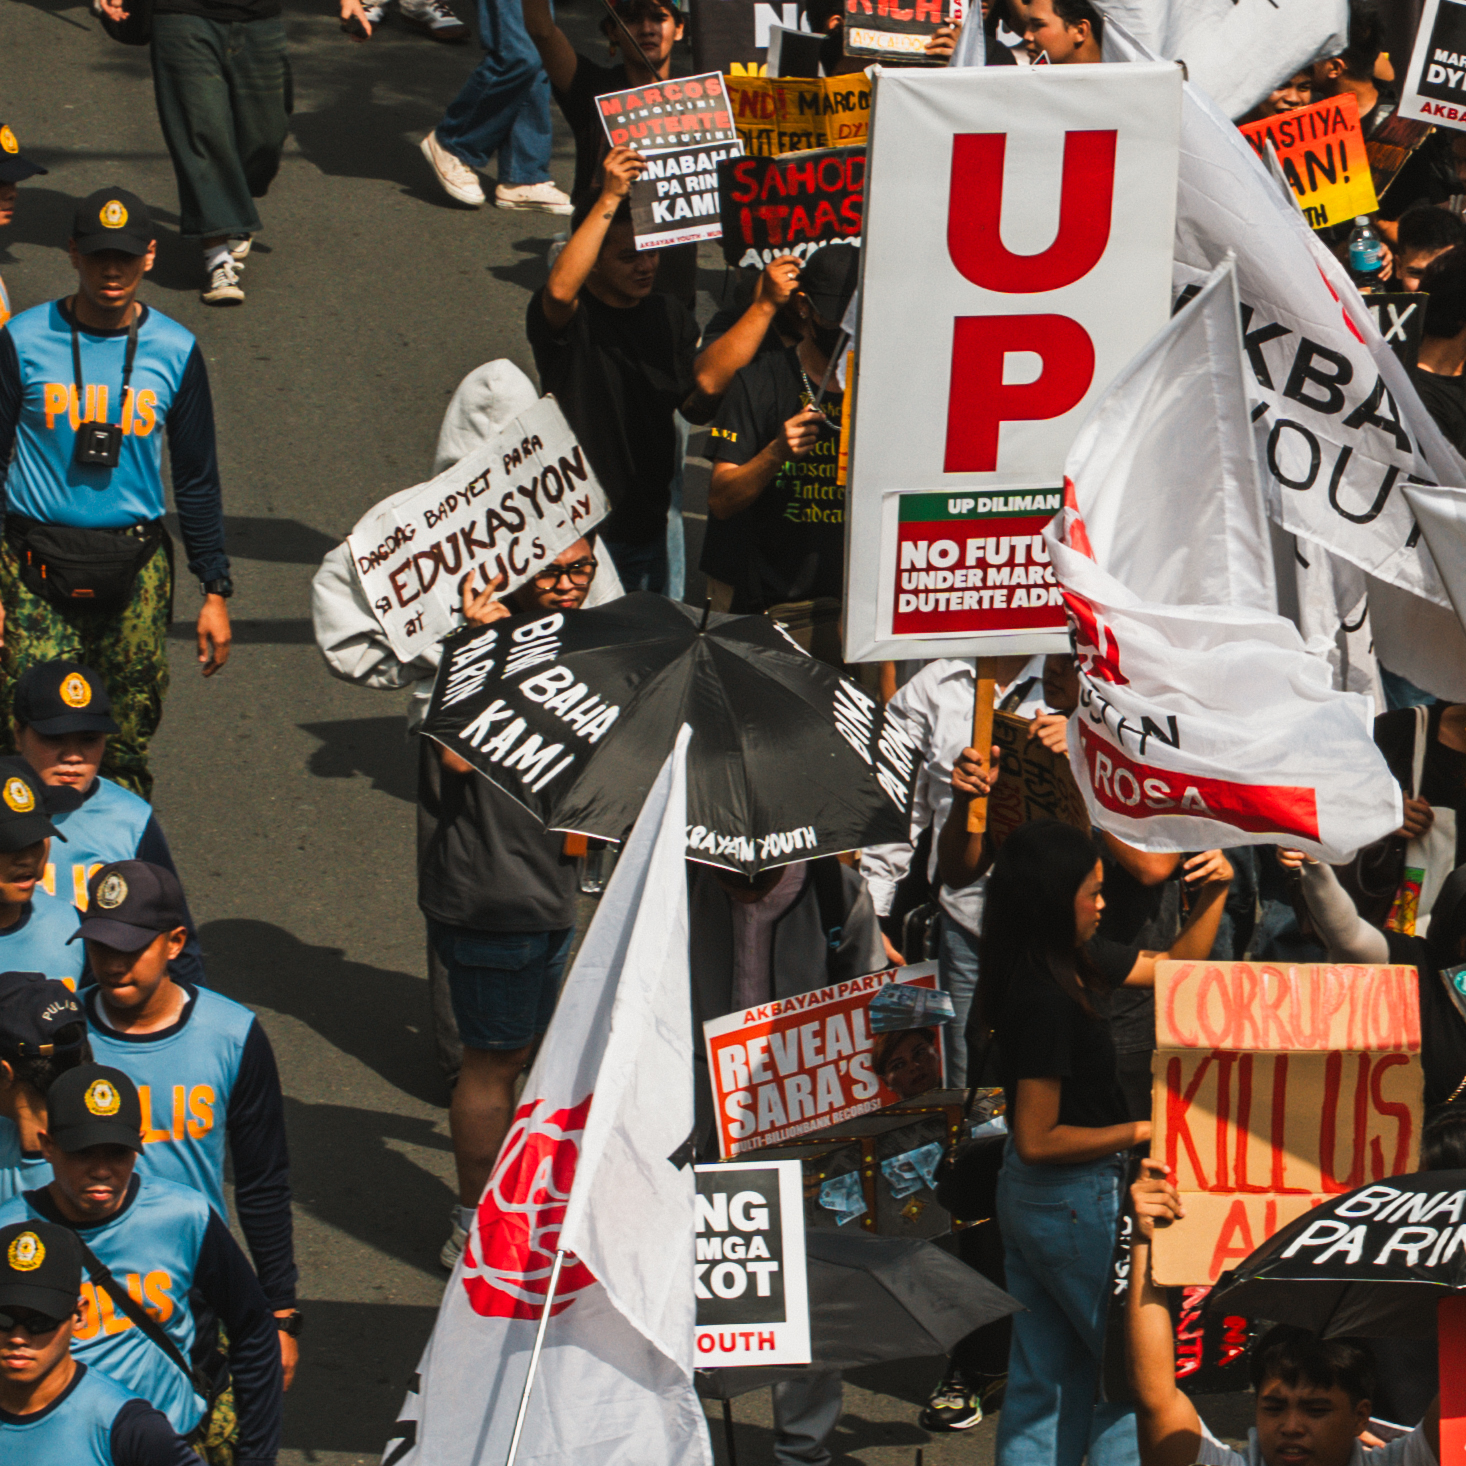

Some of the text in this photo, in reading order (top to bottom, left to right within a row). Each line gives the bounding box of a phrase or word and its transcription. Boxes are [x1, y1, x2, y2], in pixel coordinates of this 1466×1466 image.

[600, 78, 722, 116] MARCOS
[610, 110, 731, 146] DUTERTE
[656, 172, 719, 198] PA RIN
[358, 433, 544, 576] DAGDAG BADYET PARA
[947, 493, 1061, 515] UP DILIMAN
[388, 445, 588, 609] EDUKASYON
[900, 538, 961, 571] NO
[901, 568, 983, 590] UNDER
[898, 588, 1007, 614] DUTERTE
[518, 665, 621, 745] BAHA
[458, 699, 577, 794] KAMI
[759, 825, 819, 860] YOUTH
[744, 968, 899, 1026] AKBAYAN PARTY
[1164, 964, 1421, 1051] CORRUPTION
[718, 1007, 872, 1090] REVEAL
[724, 1053, 880, 1139] SARA'S
[1165, 1049, 1412, 1196] KILL US
[1335, 1184, 1466, 1223] BINA
[1281, 1218, 1366, 1266] PA
[697, 1331, 777, 1355] OUTH
